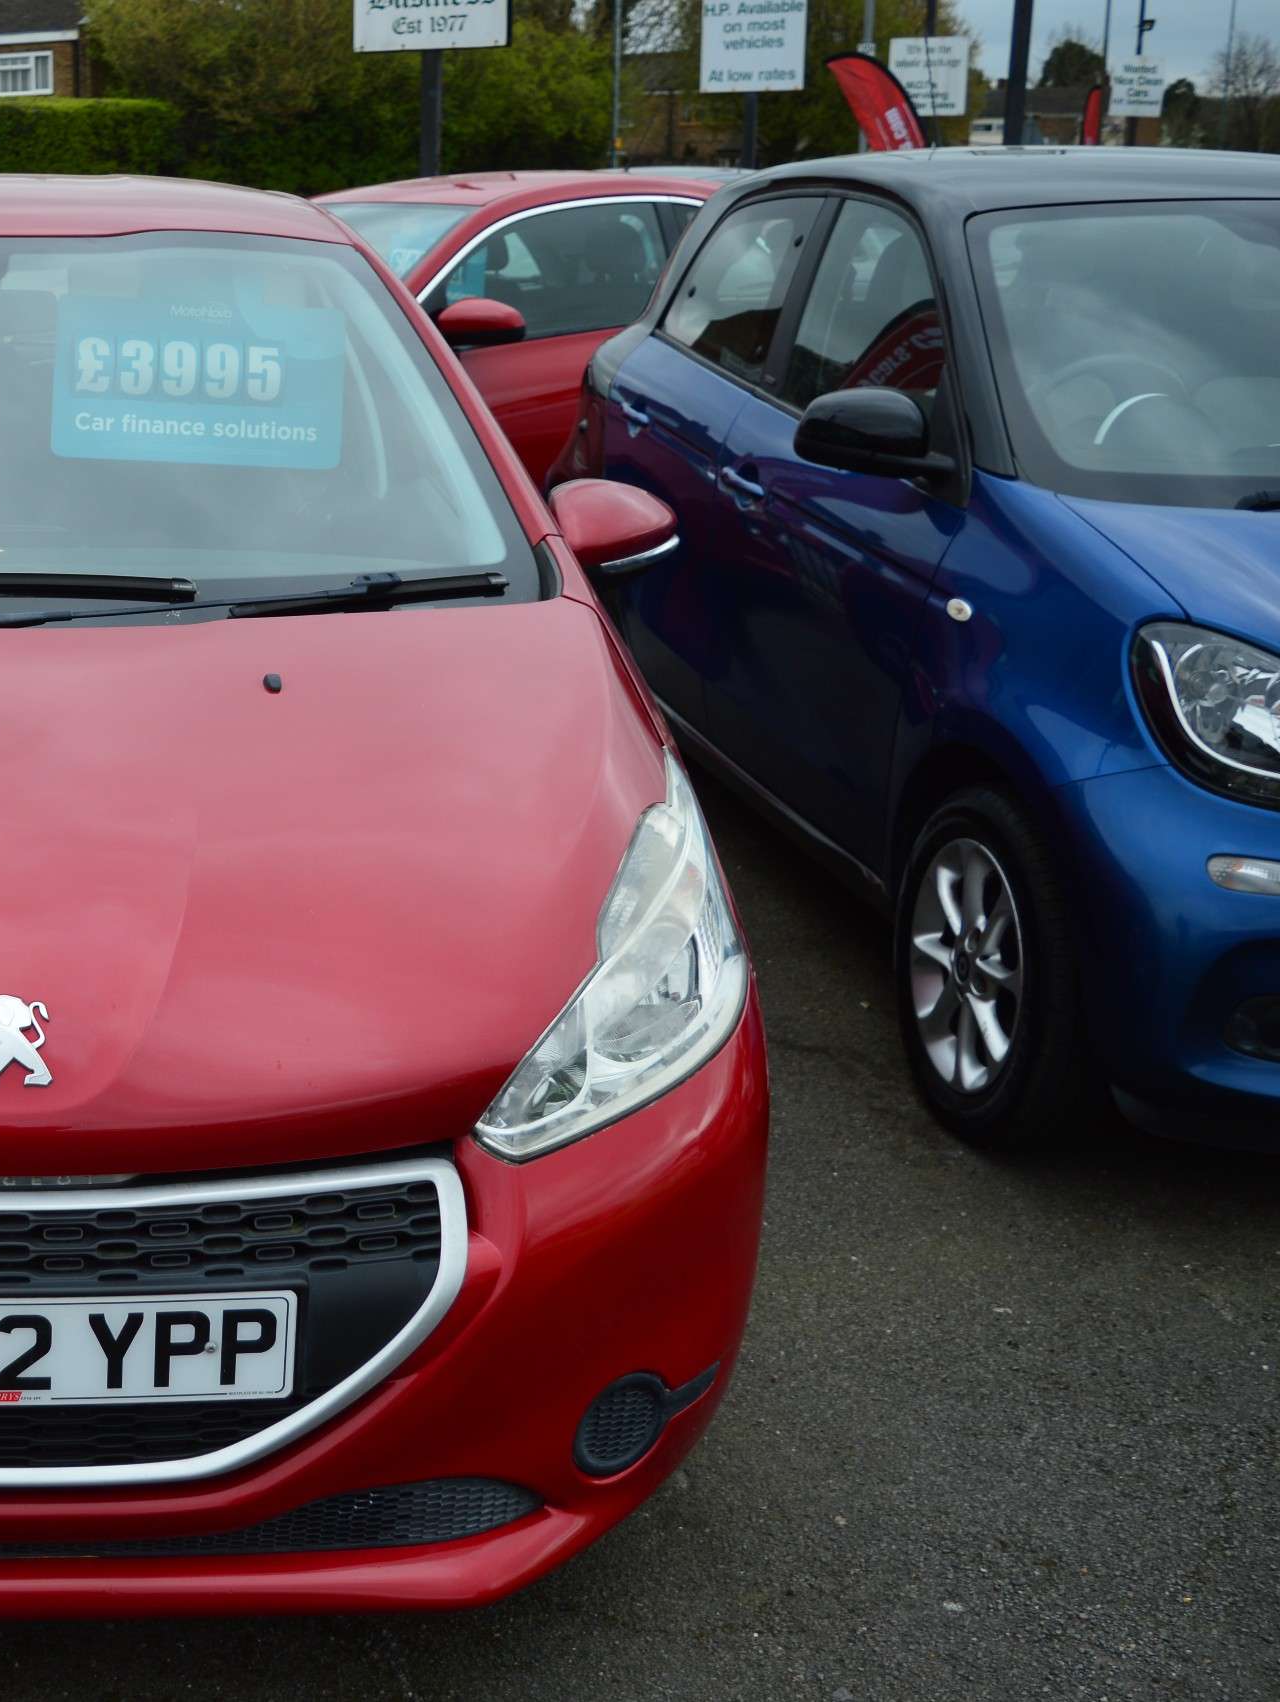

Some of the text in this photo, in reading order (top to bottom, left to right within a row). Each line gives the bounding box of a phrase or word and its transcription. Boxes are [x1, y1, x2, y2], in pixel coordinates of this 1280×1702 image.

[737, 0, 804, 14] Available
[392, 14, 467, 35] Est 1977
[723, 19, 785, 33] on most
[723, 36, 784, 49] vehicles
[708, 69, 795, 81] At low rates
[75, 337, 282, 401] £3995
[75, 412, 318, 441] Car finance solutions
[88, 1308, 278, 1389] YPP
